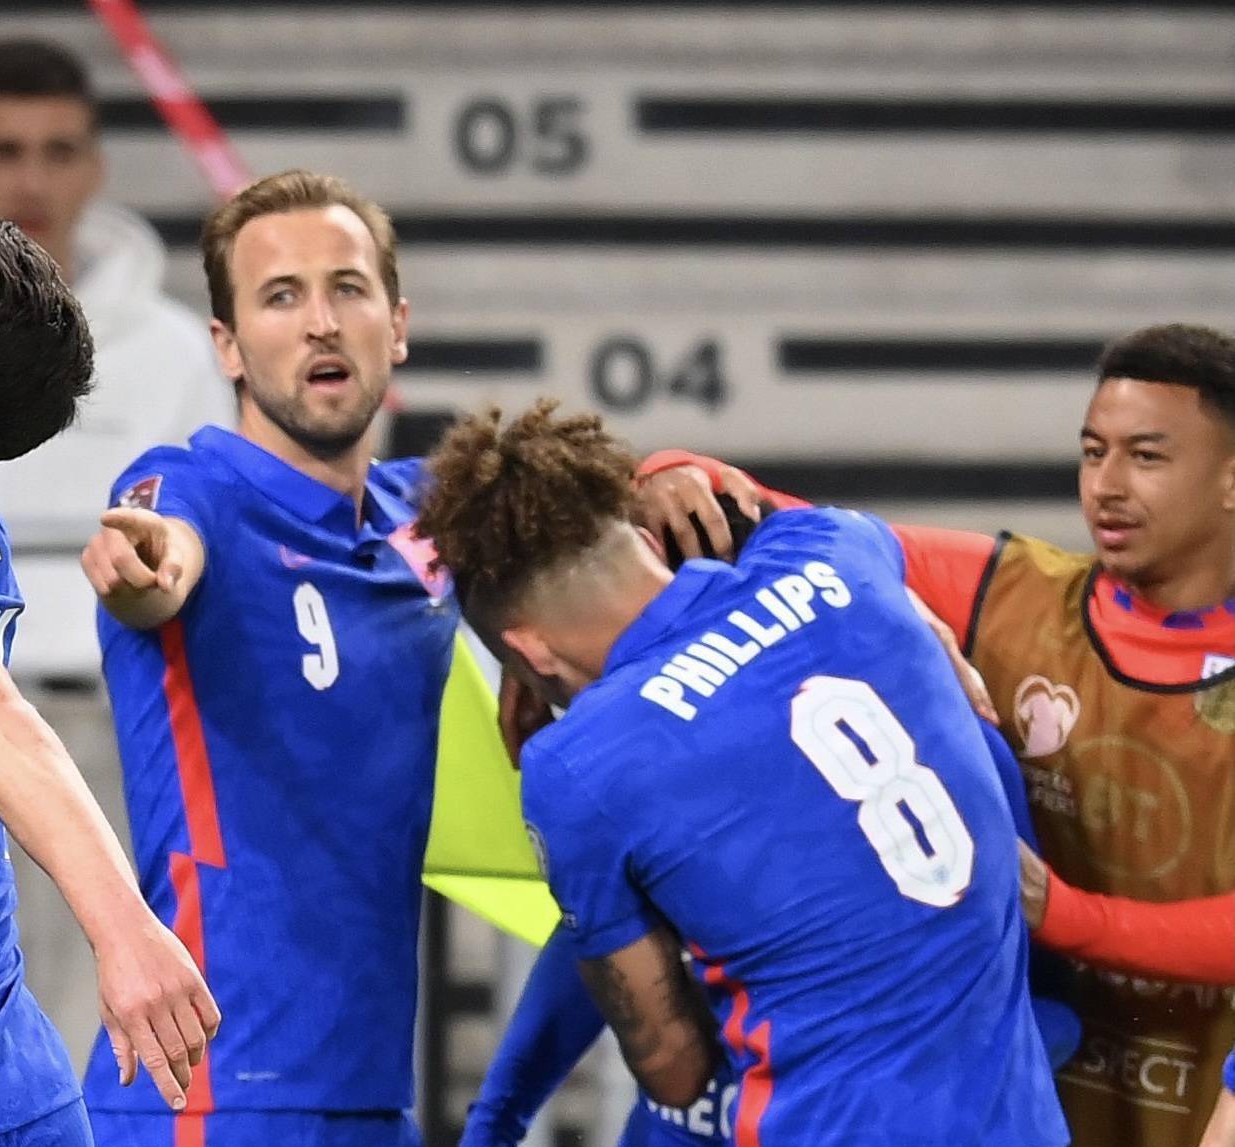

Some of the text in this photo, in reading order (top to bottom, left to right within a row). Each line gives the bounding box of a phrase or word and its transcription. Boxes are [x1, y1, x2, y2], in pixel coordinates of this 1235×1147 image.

[454, 94, 591, 178] 05
[590, 334, 726, 415] 04
[293, 582, 339, 690] 9
[639, 561, 852, 721] PHILLIPS
[790, 675, 975, 907] 8
